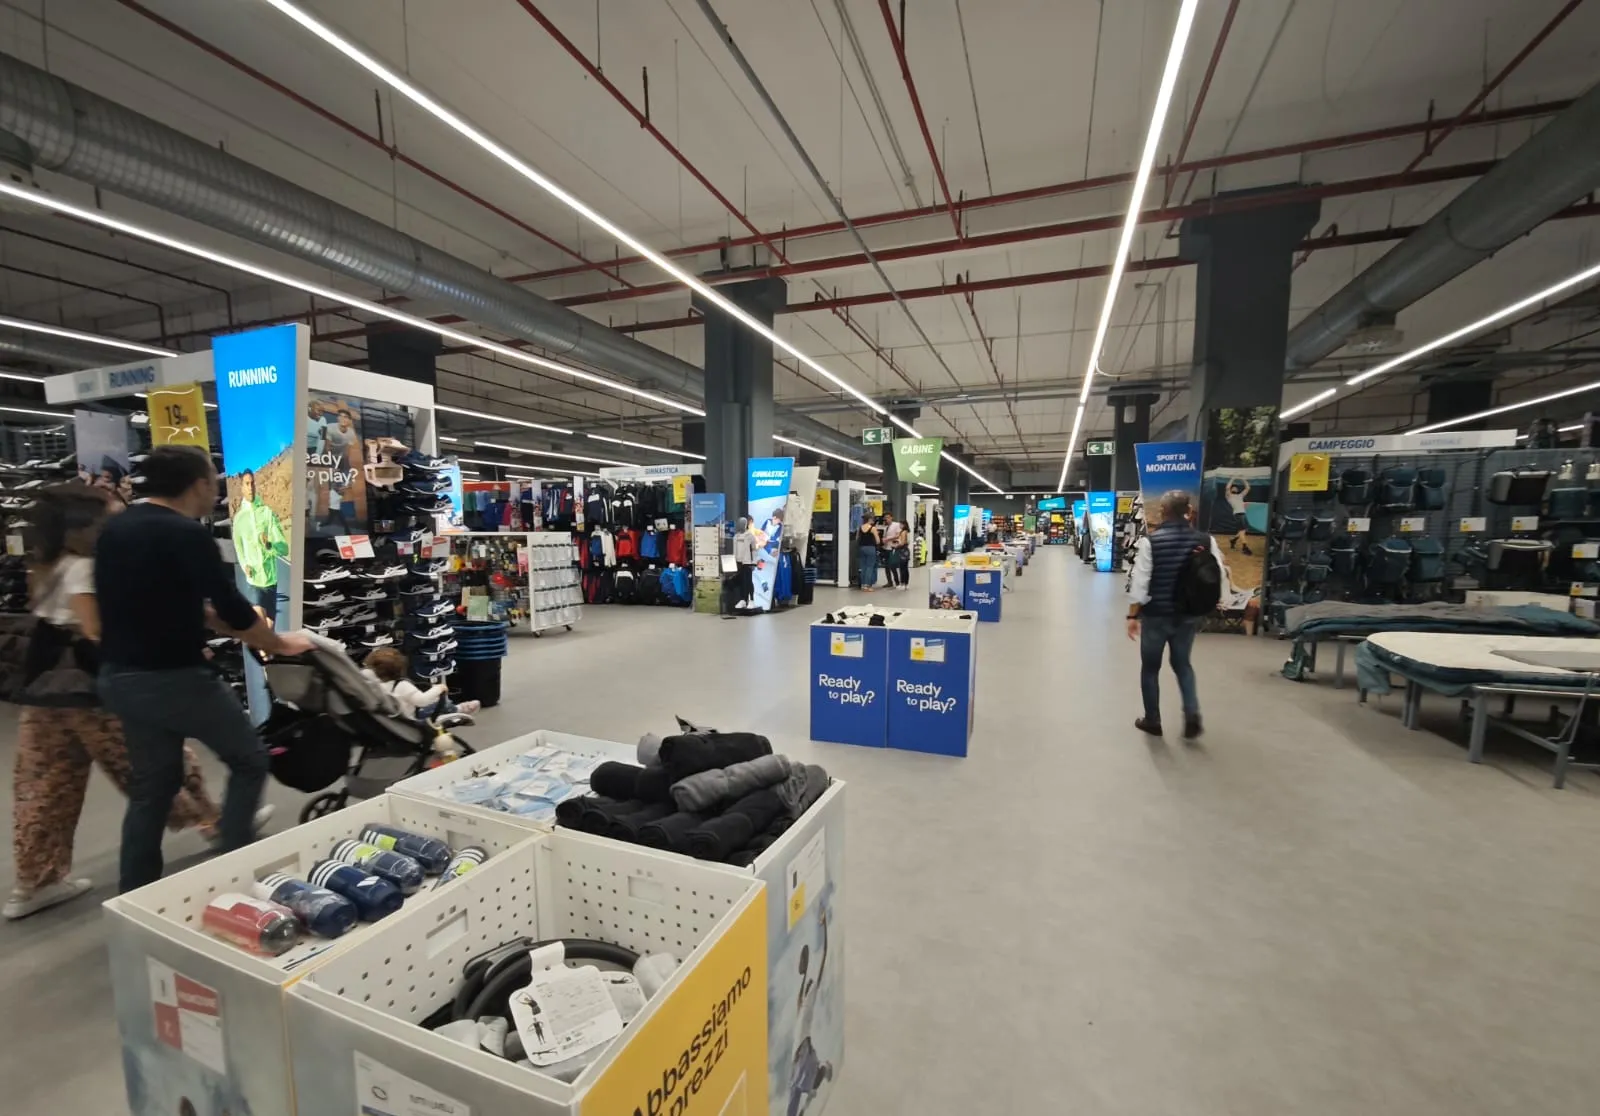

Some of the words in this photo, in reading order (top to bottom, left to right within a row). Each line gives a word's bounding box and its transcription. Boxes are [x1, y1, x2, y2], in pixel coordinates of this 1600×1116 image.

[109, 367, 155, 388] RUNNING
[228, 366, 278, 389] RUNNING
[900, 444, 935, 455] CABINE
[1308, 439, 1375, 450] CAMPEGGIO
[1156, 454, 1178, 462] SPORT
[1178, 453, 1187, 461] DI
[318, 468, 359, 486] play?
[1145, 463, 1197, 473] MONTAGNA
[819, 673, 861, 691] Ready
[896, 679, 943, 698] Ready
[828, 690, 839, 700] to
[840, 690, 876, 707] play?
[906, 696, 918, 706] to
[919, 697, 957, 714] play?
